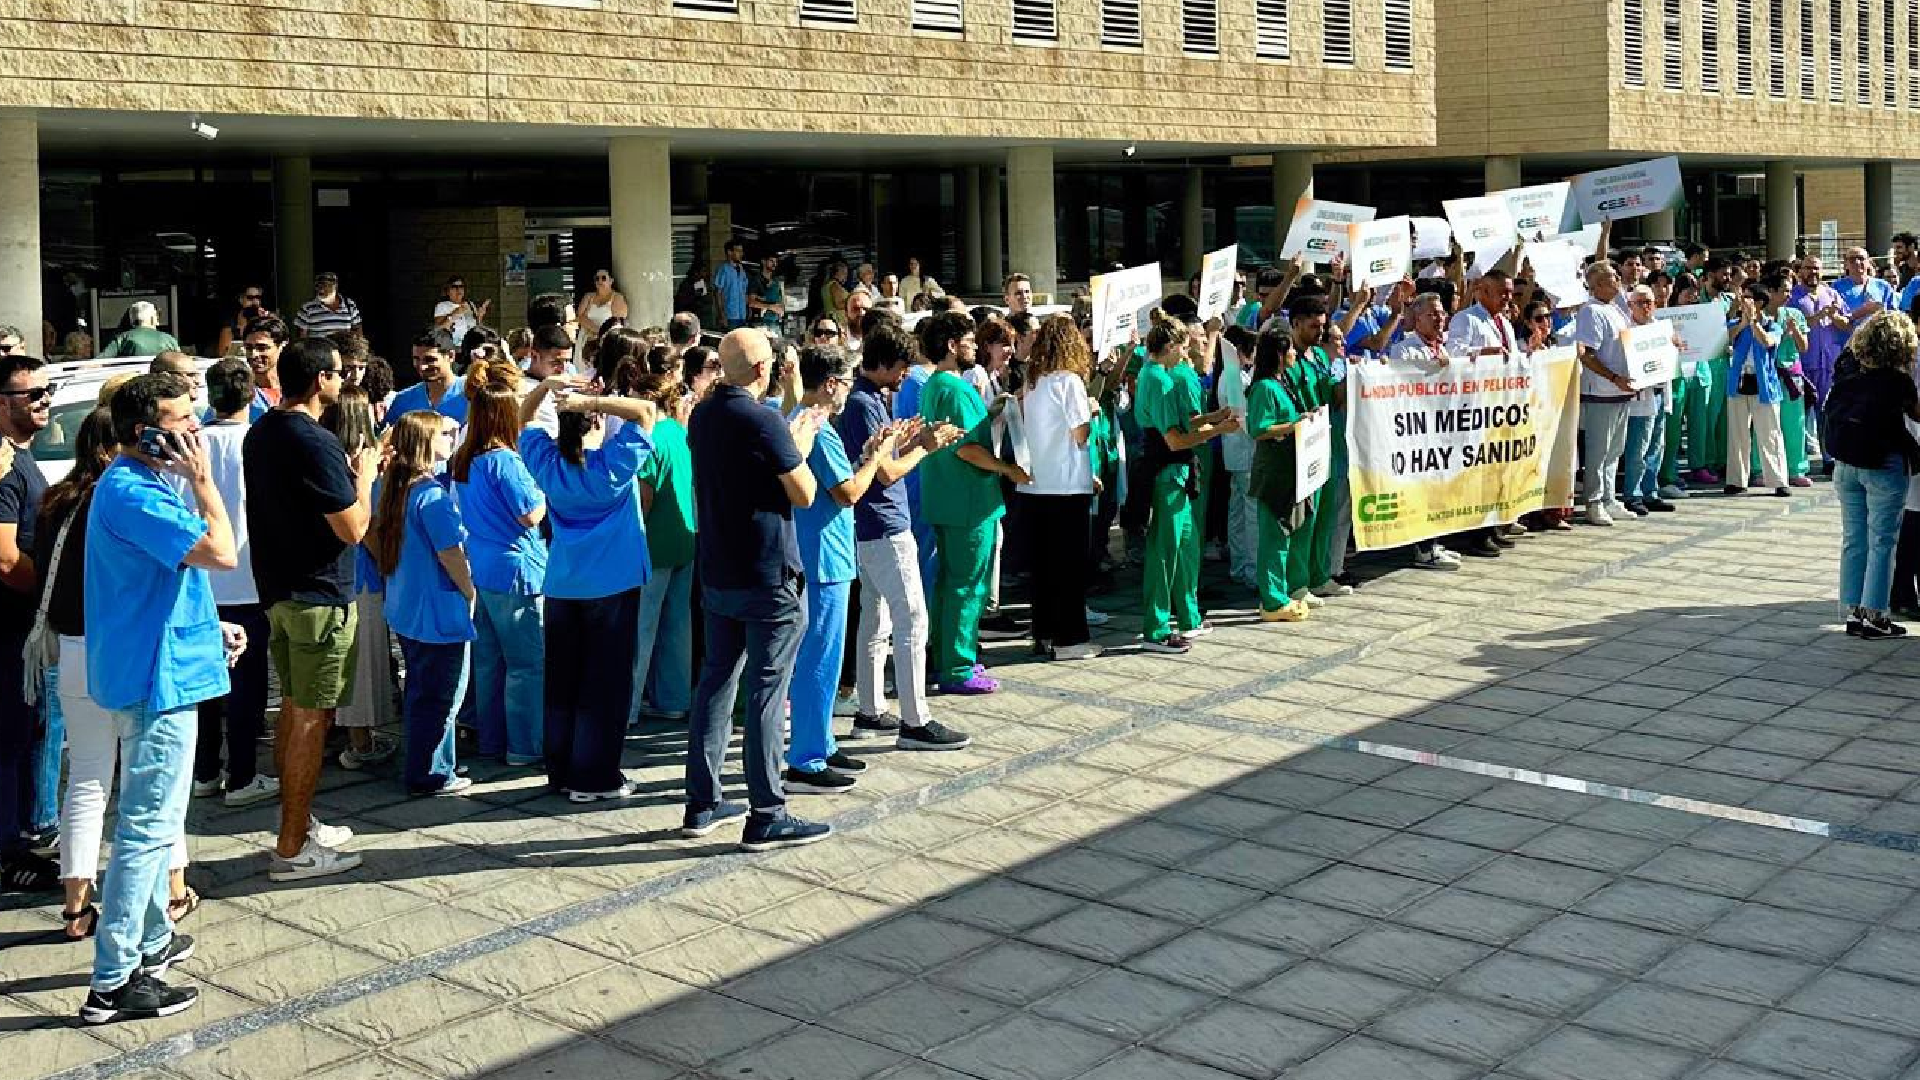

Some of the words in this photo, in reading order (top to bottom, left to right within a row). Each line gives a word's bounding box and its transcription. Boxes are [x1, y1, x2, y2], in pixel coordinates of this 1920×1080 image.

[1462, 380, 1479, 394] EN
[1394, 411, 1427, 437] SIN
[1435, 403, 1530, 434] MÉDICOS
[1411, 445, 1455, 473] HAY
[1461, 433, 1537, 468] SANIDAD
